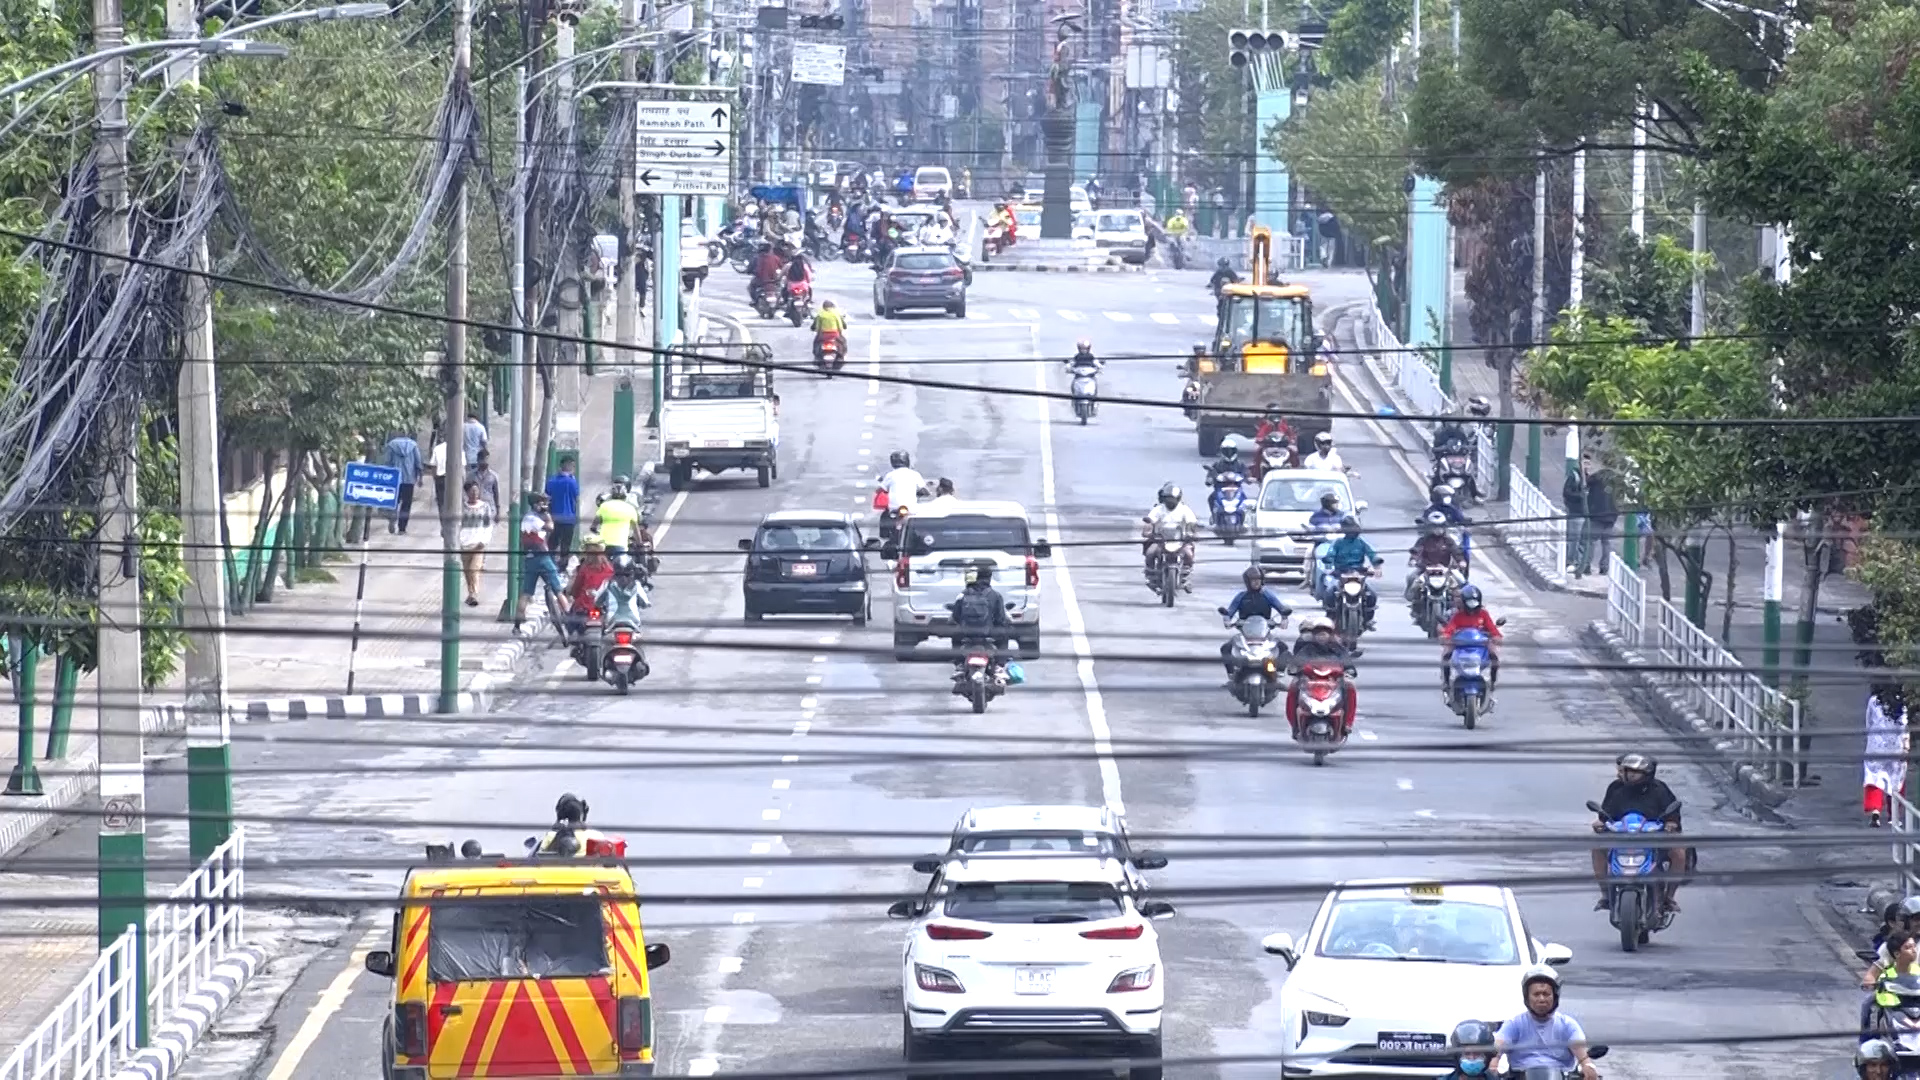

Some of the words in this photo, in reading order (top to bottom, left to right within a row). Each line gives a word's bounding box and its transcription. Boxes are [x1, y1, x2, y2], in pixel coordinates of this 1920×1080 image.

[640, 119, 681, 128] Ramshah
[684, 120, 705, 128] Path
[640, 150, 667, 159] Singh
[669, 150, 702, 158] Durbar
[353, 469, 369, 478] BUS
[372, 471, 393, 481] STOP
